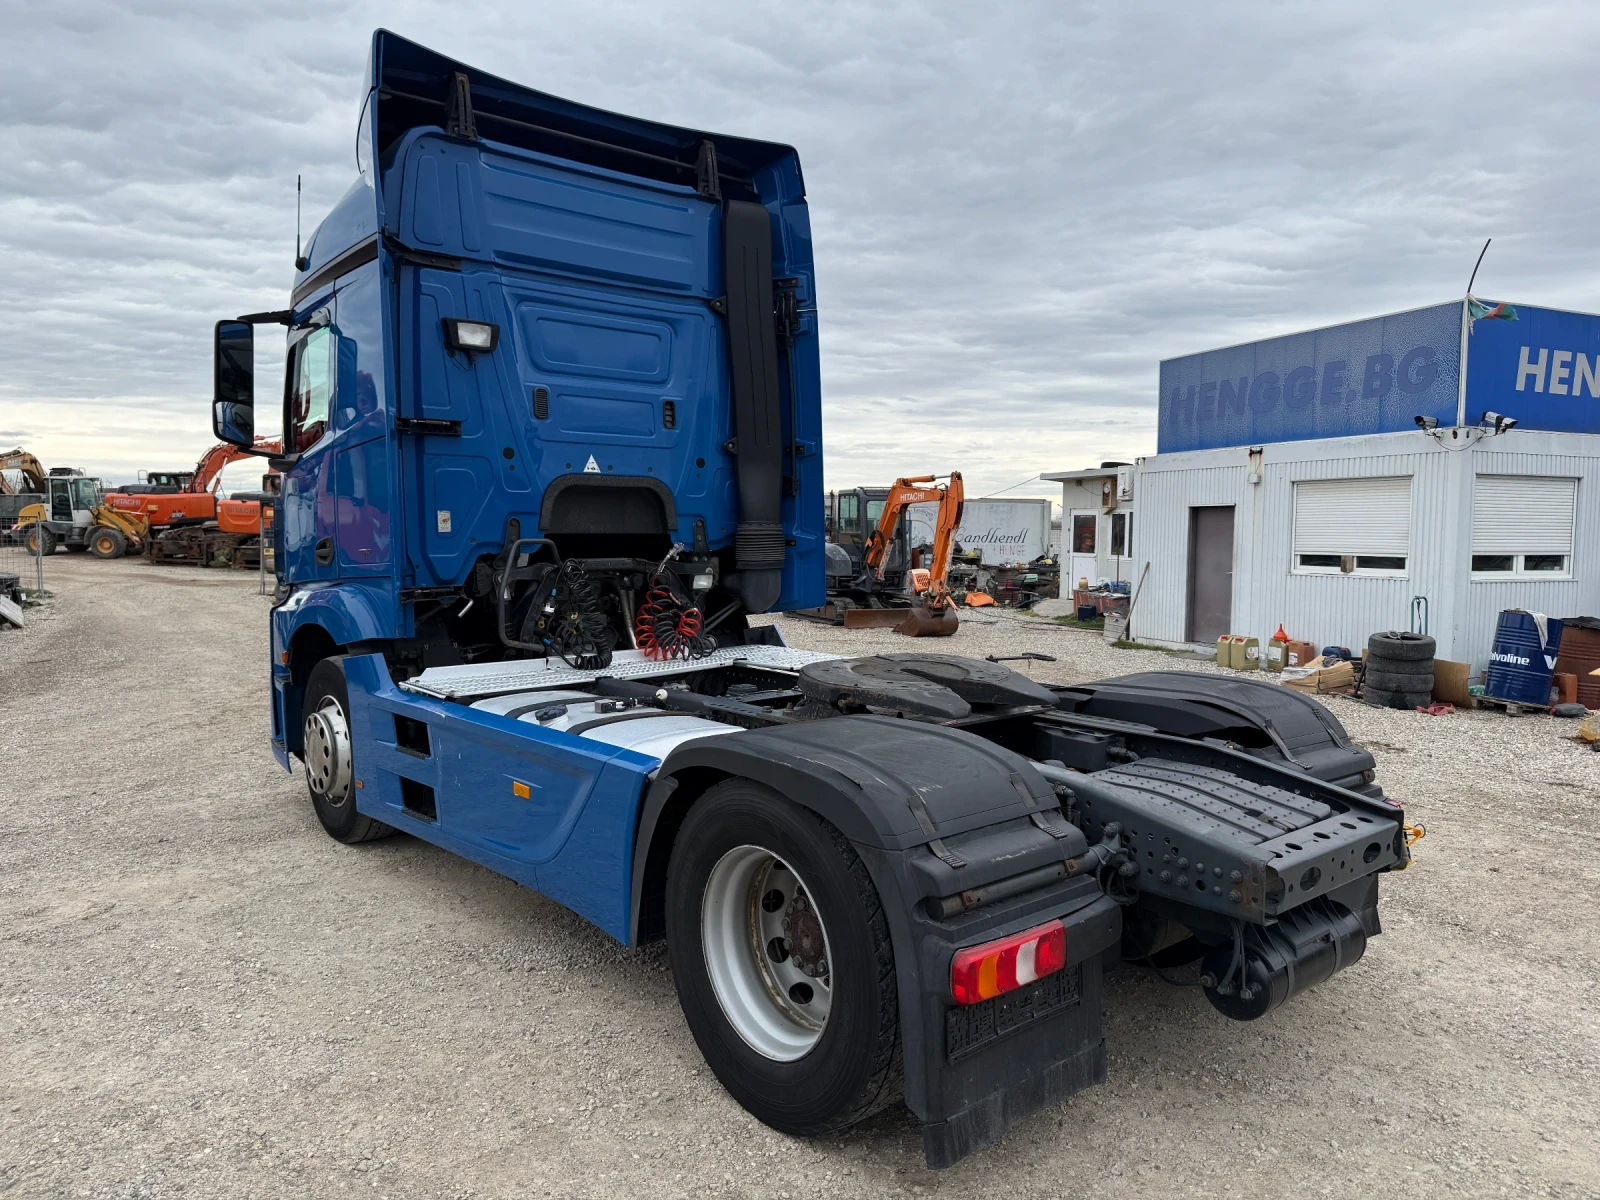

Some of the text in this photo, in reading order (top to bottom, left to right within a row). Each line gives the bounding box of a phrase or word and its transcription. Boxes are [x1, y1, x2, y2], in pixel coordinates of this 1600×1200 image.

[1516, 346, 1600, 398] HEN
[1168, 346, 1439, 425] HENGGE.BG
[900, 491, 925, 502] HITACHI
[227, 507, 259, 515] HITACHI
[1489, 652, 1530, 666] alvoline
